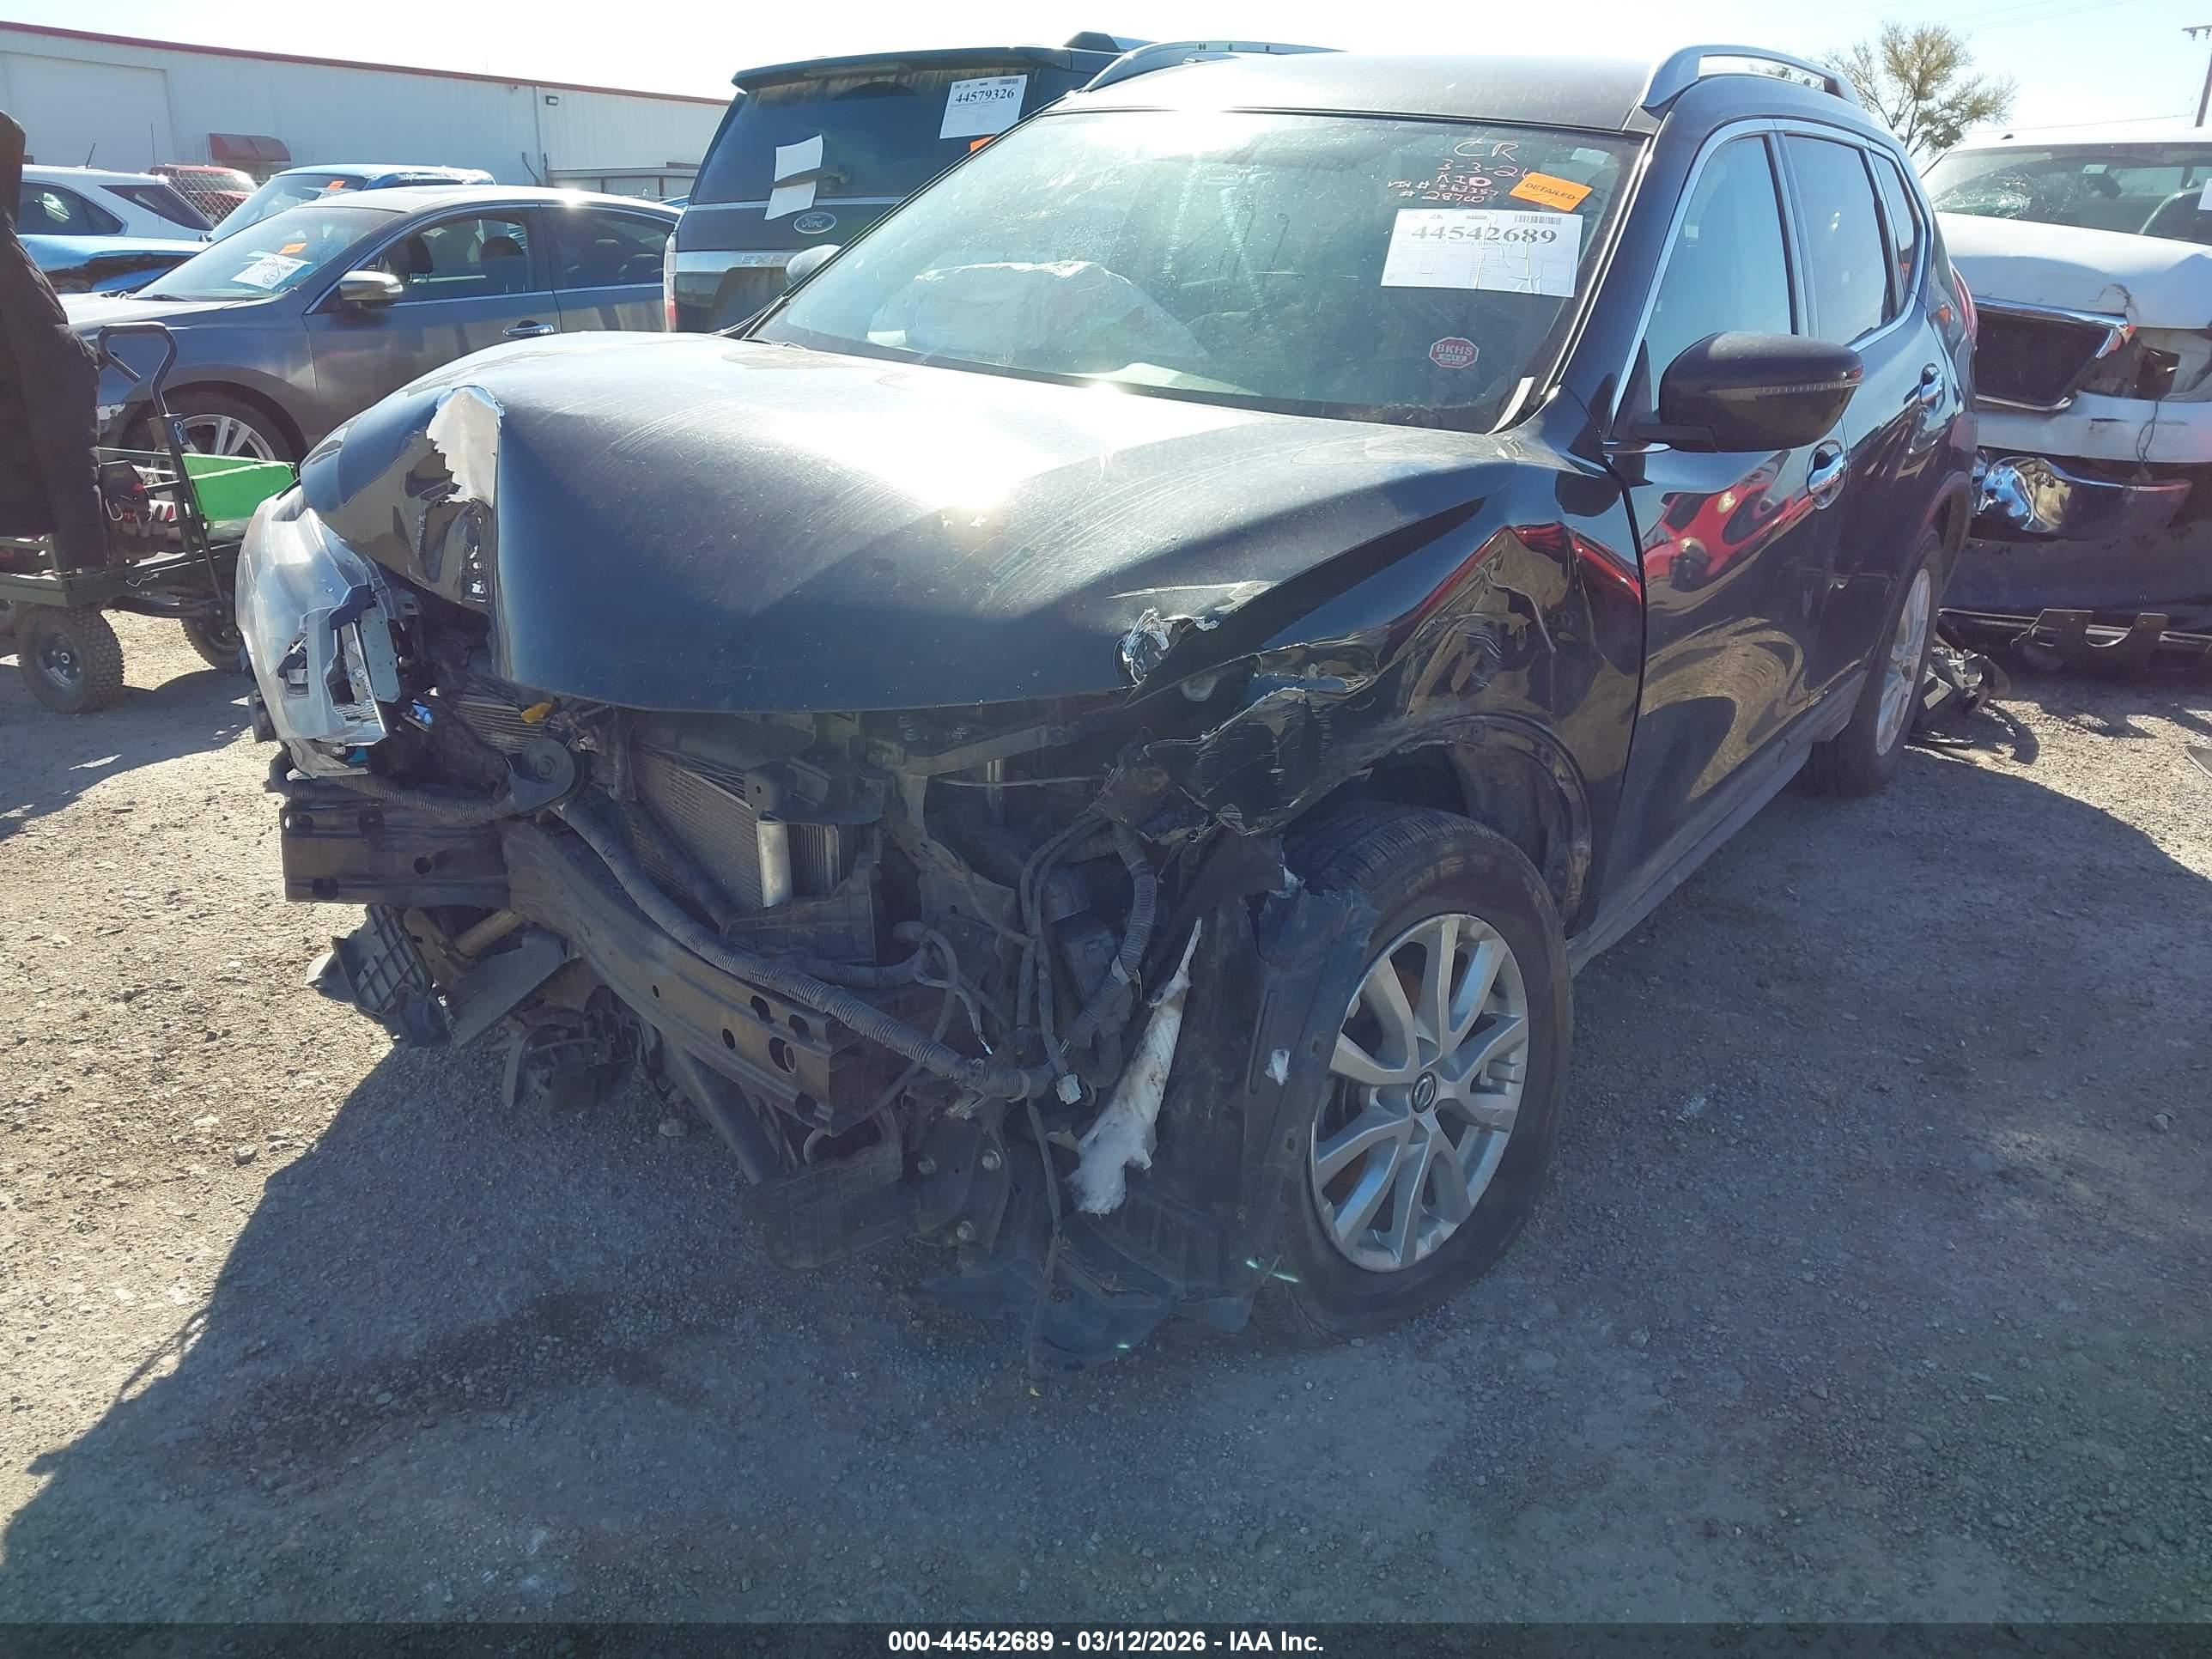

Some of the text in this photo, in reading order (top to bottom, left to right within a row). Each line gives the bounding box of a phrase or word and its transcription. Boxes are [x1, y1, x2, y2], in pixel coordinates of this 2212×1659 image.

[955, 88, 1014, 103] 44579326
[1524, 182, 1576, 200] DETAILED
[801, 216, 826, 228] Ford
[1412, 226, 1557, 244] 44542689
